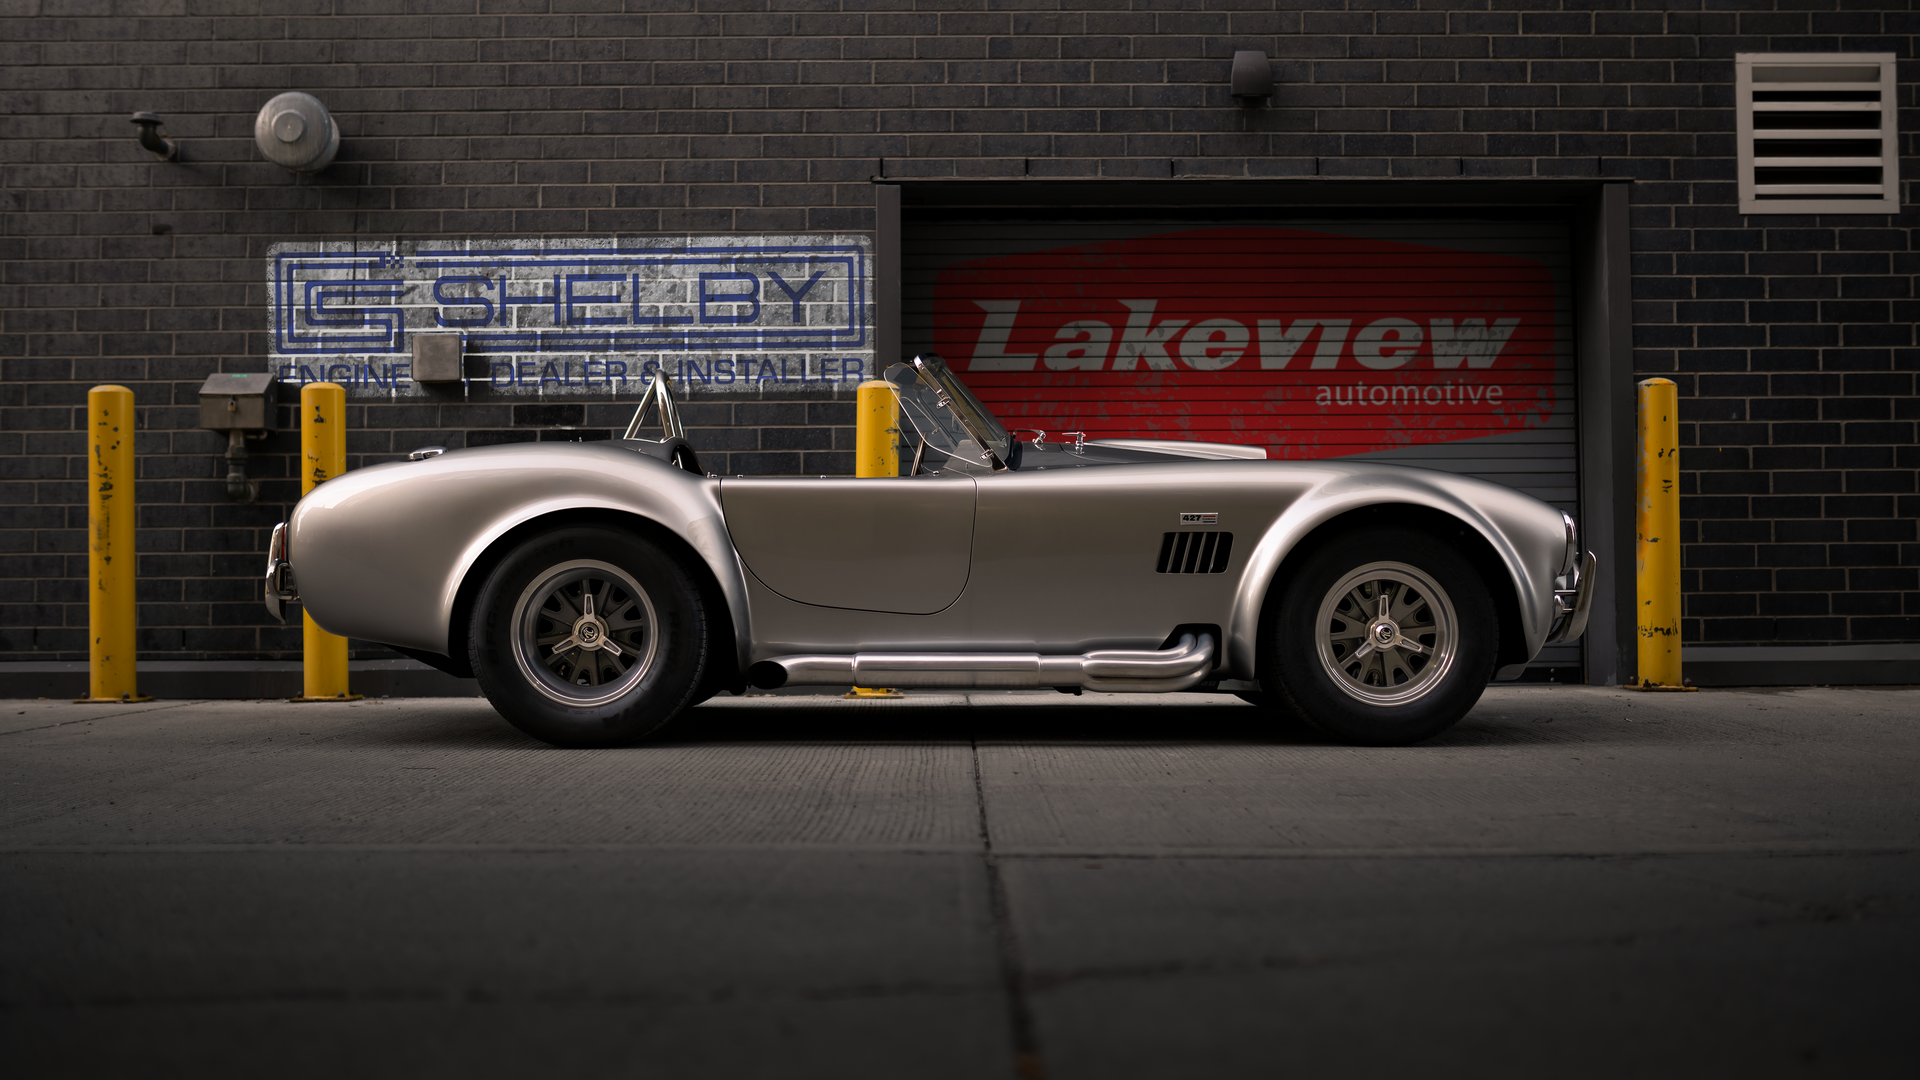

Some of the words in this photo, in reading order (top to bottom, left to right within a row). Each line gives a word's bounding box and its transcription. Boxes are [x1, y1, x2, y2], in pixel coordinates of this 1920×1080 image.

[433, 271, 826, 327] SHELBY
[966, 299, 1522, 372] Lakeview
[279, 363, 411, 388] ENGINE
[491, 360, 627, 387] DEALER
[640, 360, 661, 386] &
[678, 358, 864, 385] INSTALLER
[1316, 378, 1503, 406] automotive
